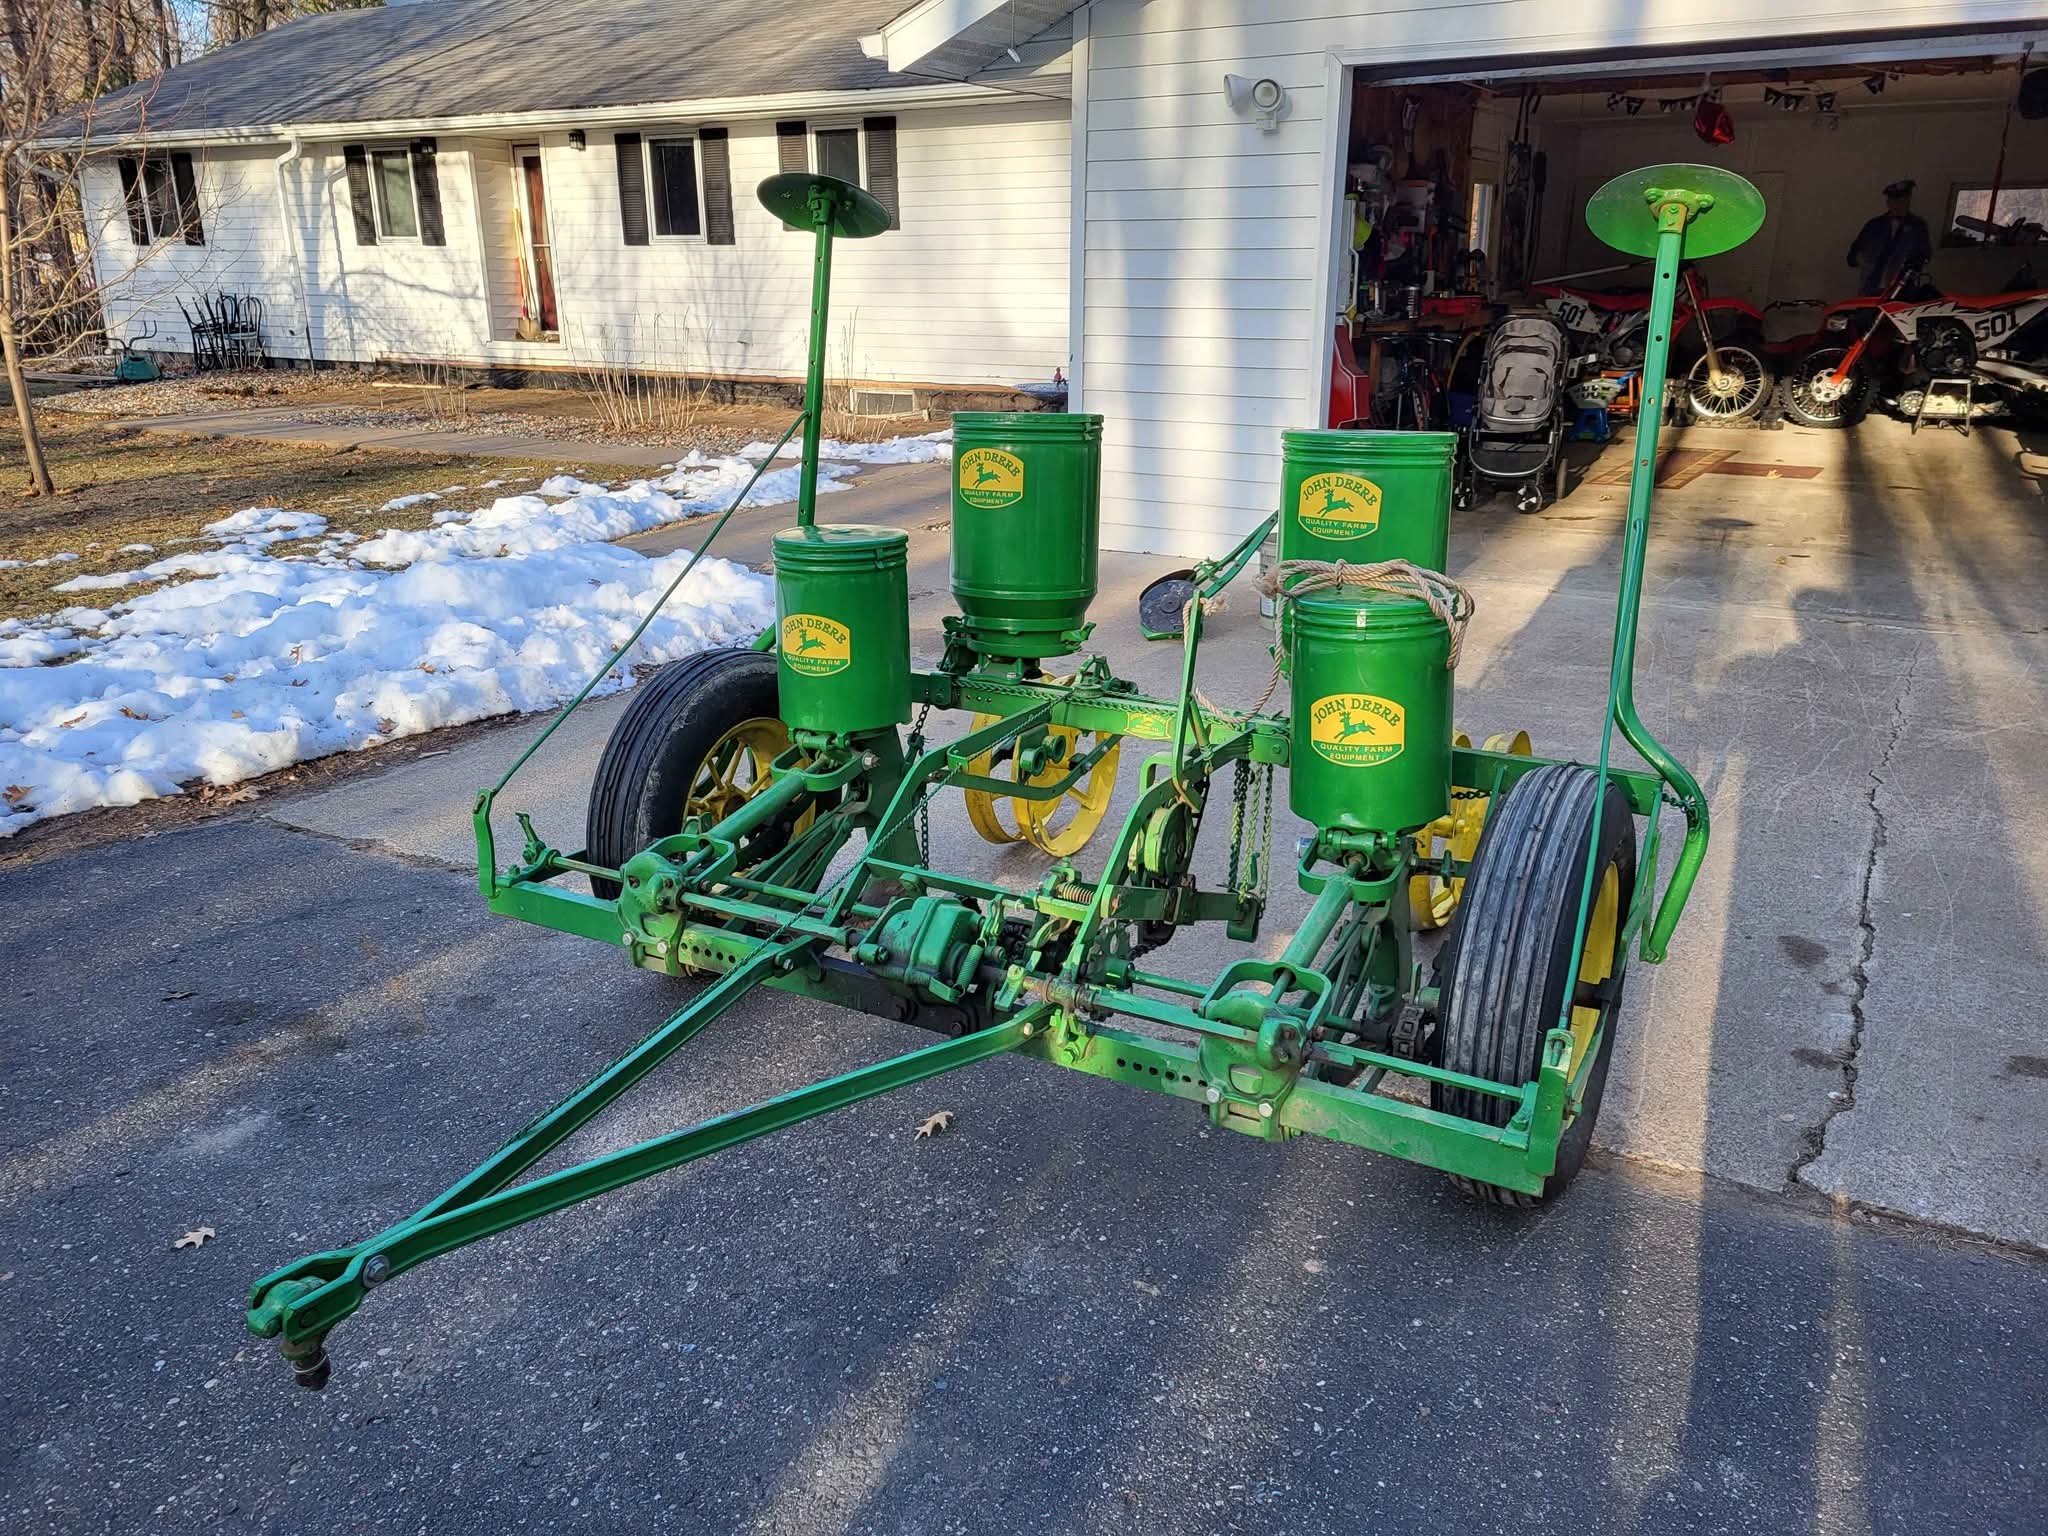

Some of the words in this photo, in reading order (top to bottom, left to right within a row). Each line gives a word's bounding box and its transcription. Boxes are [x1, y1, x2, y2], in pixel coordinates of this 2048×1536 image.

[1556, 302, 1587, 327] 501
[1975, 310, 2018, 343] 501
[961, 452, 981, 474] JOHN
[984, 451, 1021, 477] DEERE
[1303, 476, 1332, 500] JOHN
[1335, 476, 1378, 506] DEERE
[969, 497, 1004, 505] EQMENT
[1305, 518, 1339, 527] QUALITY
[1342, 521, 1368, 529] FARM
[1312, 526, 1355, 536] EQUIPMENT
[784, 618, 803, 638] JOHN
[807, 618, 847, 644] DEERE
[787, 654, 815, 663] QUALITY
[1314, 698, 1346, 724] JOHN
[1351, 698, 1401, 727] DEERE
[1320, 743, 1360, 752] QUALITY
[1364, 745, 1393, 753] FARM
[1329, 752, 1380, 761] EQUIPMENT
